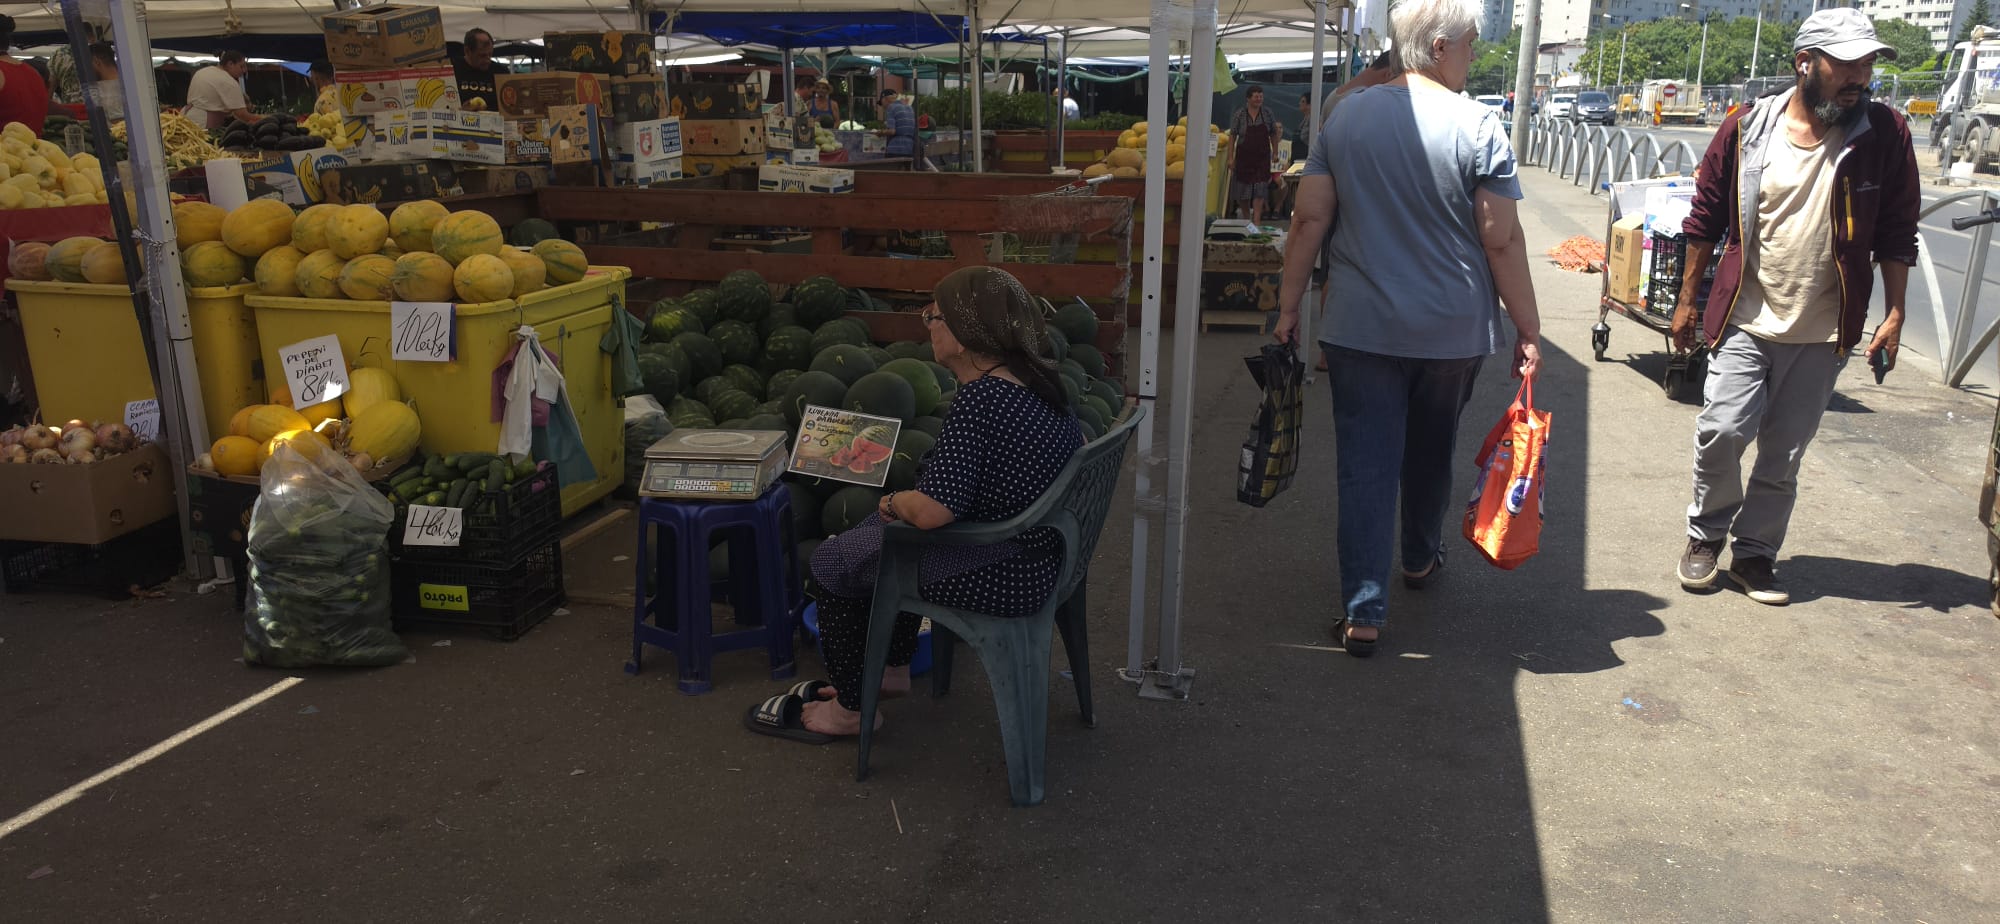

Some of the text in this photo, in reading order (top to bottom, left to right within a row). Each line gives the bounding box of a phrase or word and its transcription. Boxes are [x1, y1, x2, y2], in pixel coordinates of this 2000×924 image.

[460, 81, 493, 92] BOSS
[520, 140, 545, 149] Mister
[516, 145, 550, 155] Banana
[820, 433, 835, 447] 6
